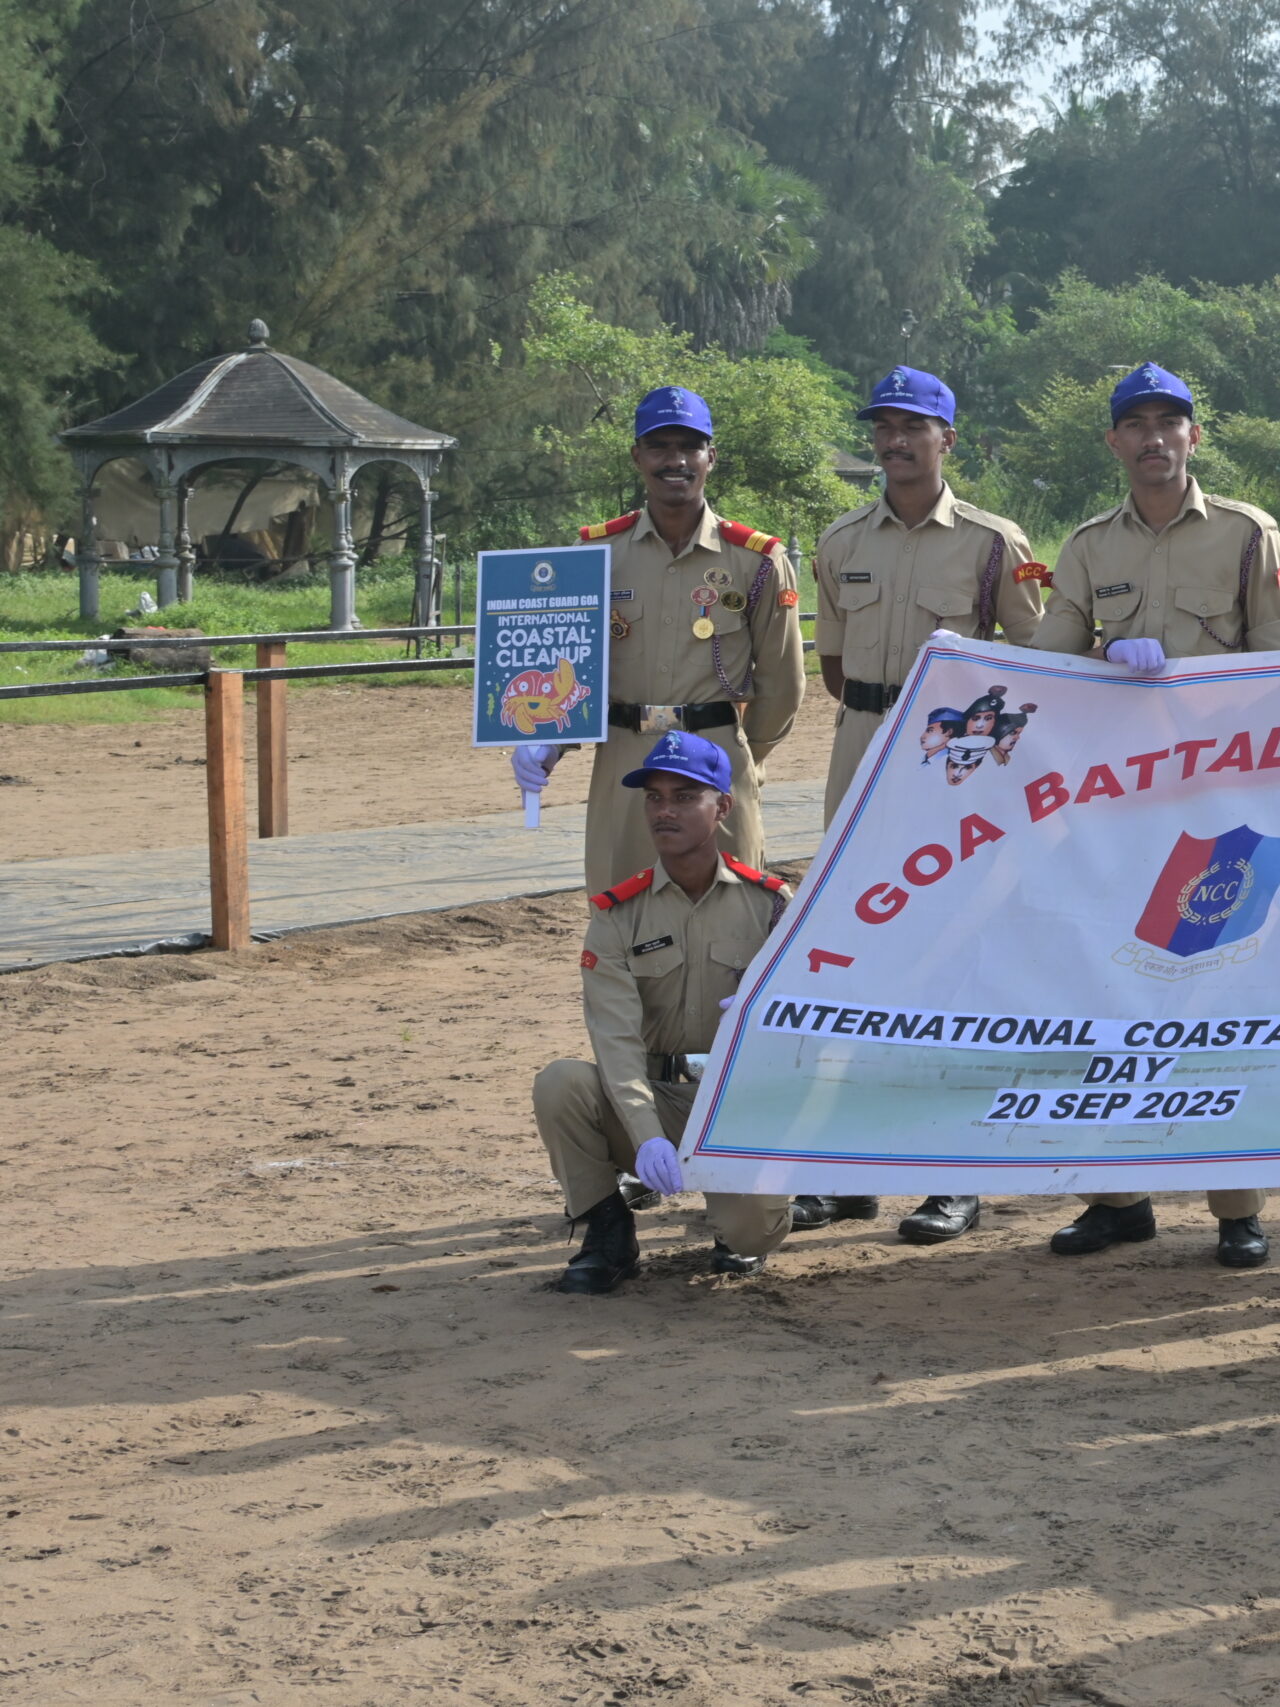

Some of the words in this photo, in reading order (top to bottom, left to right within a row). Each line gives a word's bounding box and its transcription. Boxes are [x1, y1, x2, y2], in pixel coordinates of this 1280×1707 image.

[1018, 566, 1042, 580] NCC
[487, 599, 518, 611] INDIAN
[518, 597, 548, 609] COAST
[549, 596, 579, 608] GUARD
[580, 595, 599, 606] GOA
[498, 612, 591, 627] INTERNATIONAL
[496, 625, 592, 648] COASTAL
[496, 645, 592, 668] CLEANUP
[808, 947, 855, 974] 1
[854, 812, 1006, 926] GOA
[1193, 881, 1239, 902] NCC
[762, 1000, 1098, 1046] INTERNATIONAL
[1082, 1056, 1174, 1084] DAY
[988, 1092, 1041, 1120] 20
[1049, 1092, 1132, 1120] SEP
[1133, 1089, 1241, 1120] 2025
